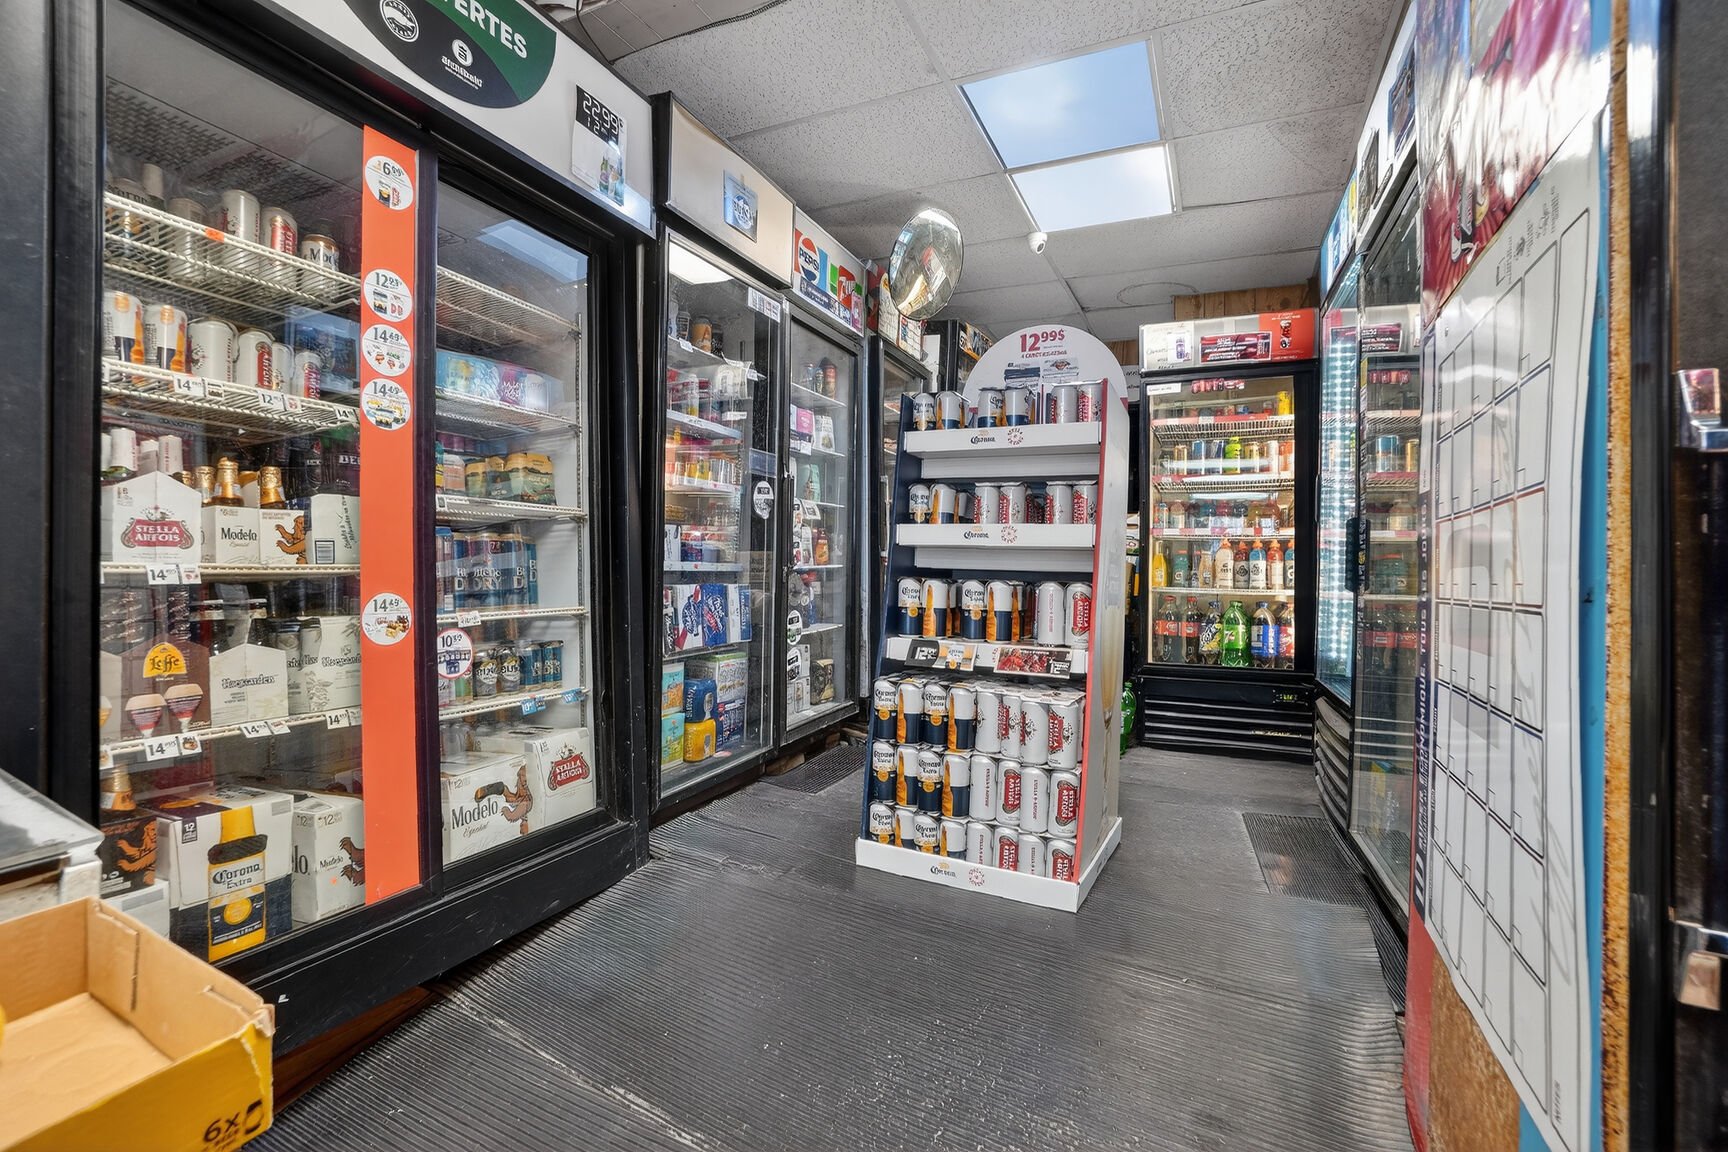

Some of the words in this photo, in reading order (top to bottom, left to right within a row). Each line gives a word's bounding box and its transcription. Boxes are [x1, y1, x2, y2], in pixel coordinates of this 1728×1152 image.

[444, 0, 528, 59] ERTES
[135, 525, 179, 534] STELLA
[221, 528, 257, 541] Modelo
[149, 654, 180, 672] Leffe
[451, 799, 498, 830] Modelo
[212, 863, 262, 885] Corona
[226, 877, 252, 889] Extra
